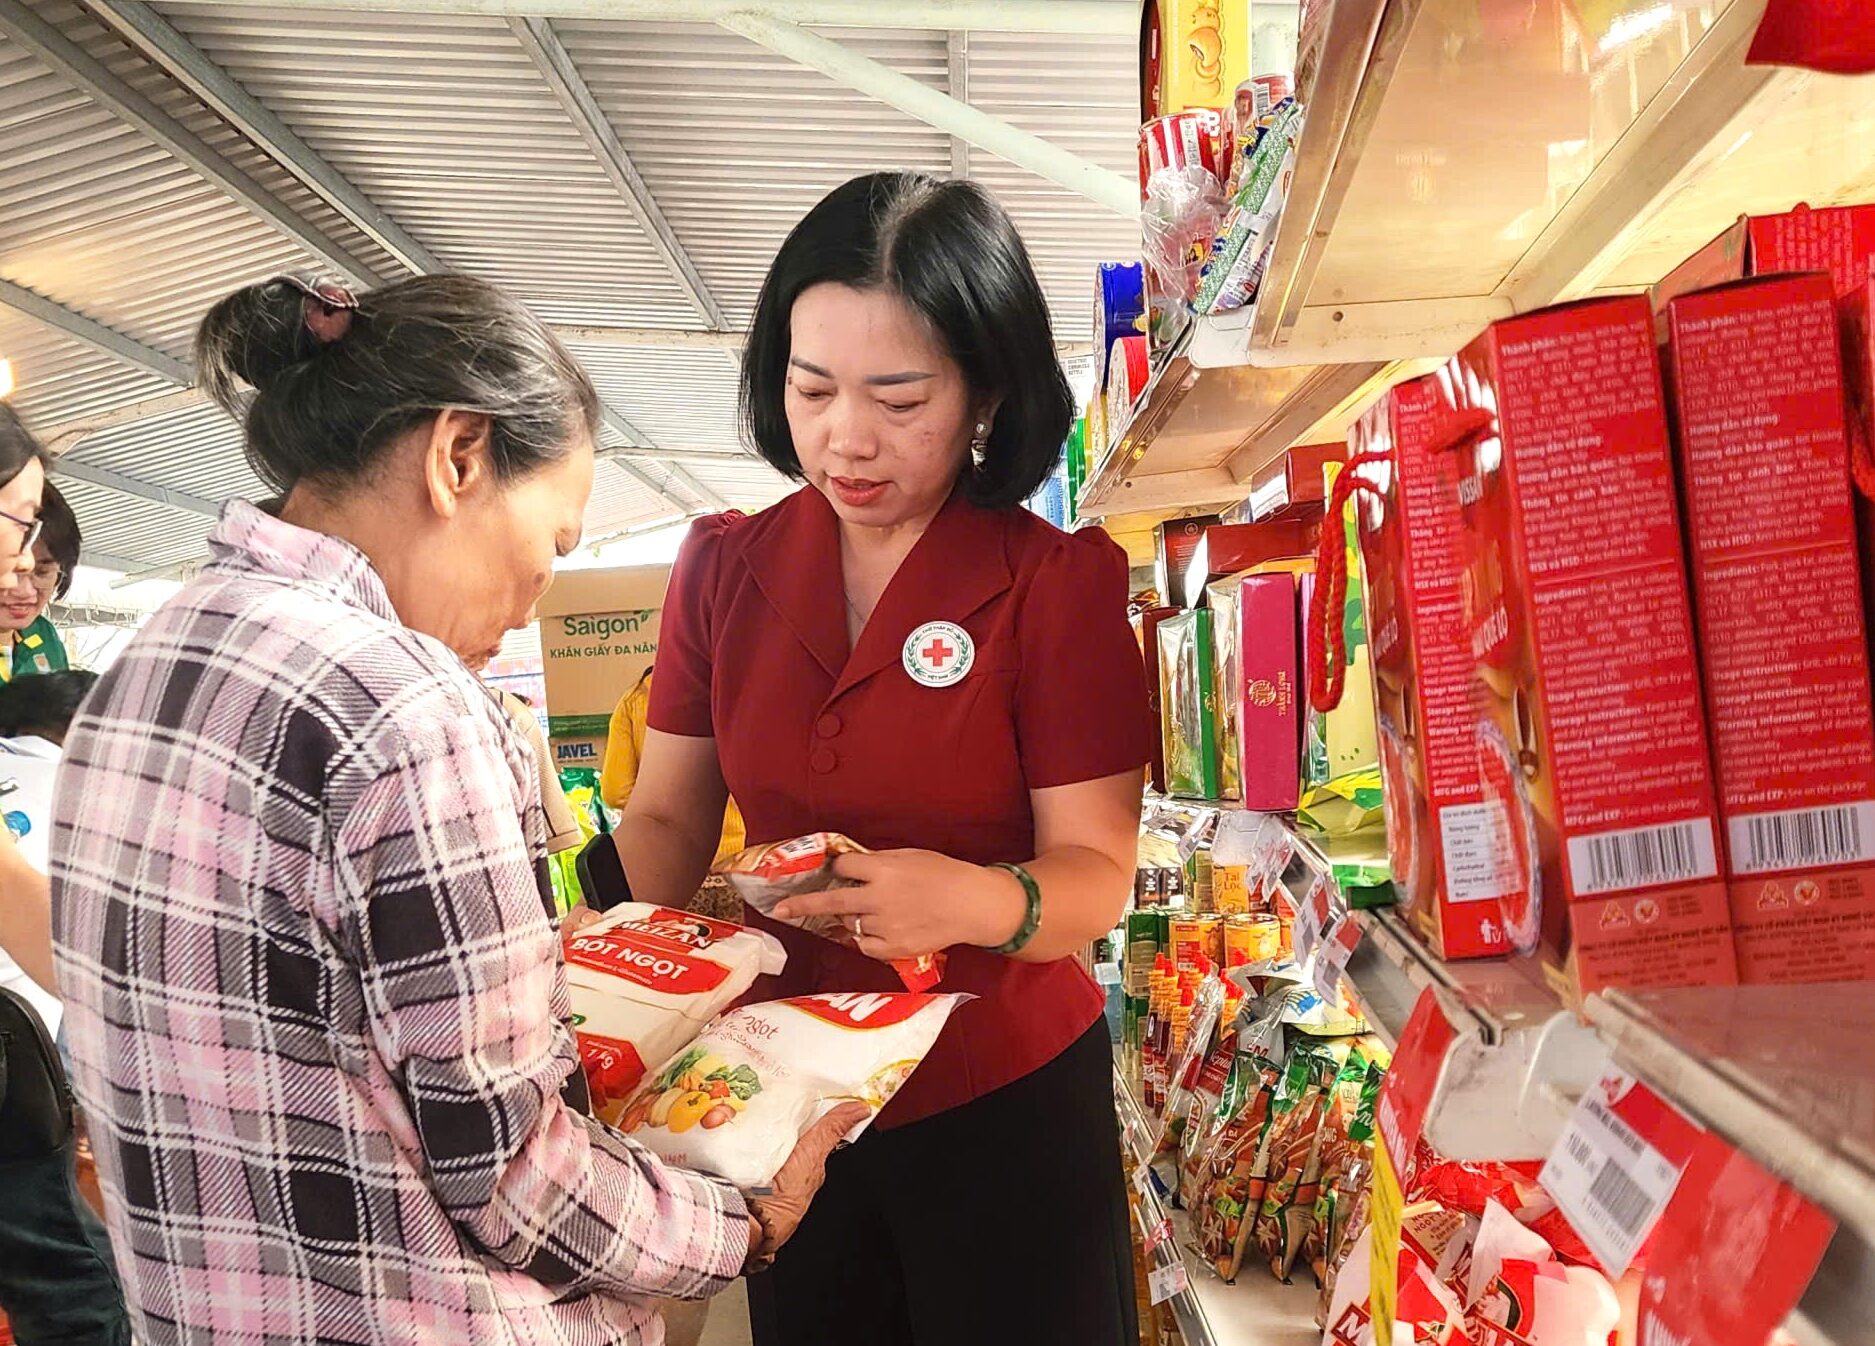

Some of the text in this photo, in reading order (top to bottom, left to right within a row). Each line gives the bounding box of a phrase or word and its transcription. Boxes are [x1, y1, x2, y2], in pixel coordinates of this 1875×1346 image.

[564, 616, 638, 640] Saigon
[584, 642, 611, 656] GIẤY
[615, 645, 631, 654] ĐA
[634, 641, 657, 653] NĂN
[614, 920, 714, 949] MEIZAN
[570, 938, 618, 954] BỘT
[616, 947, 689, 979] NGỌT
